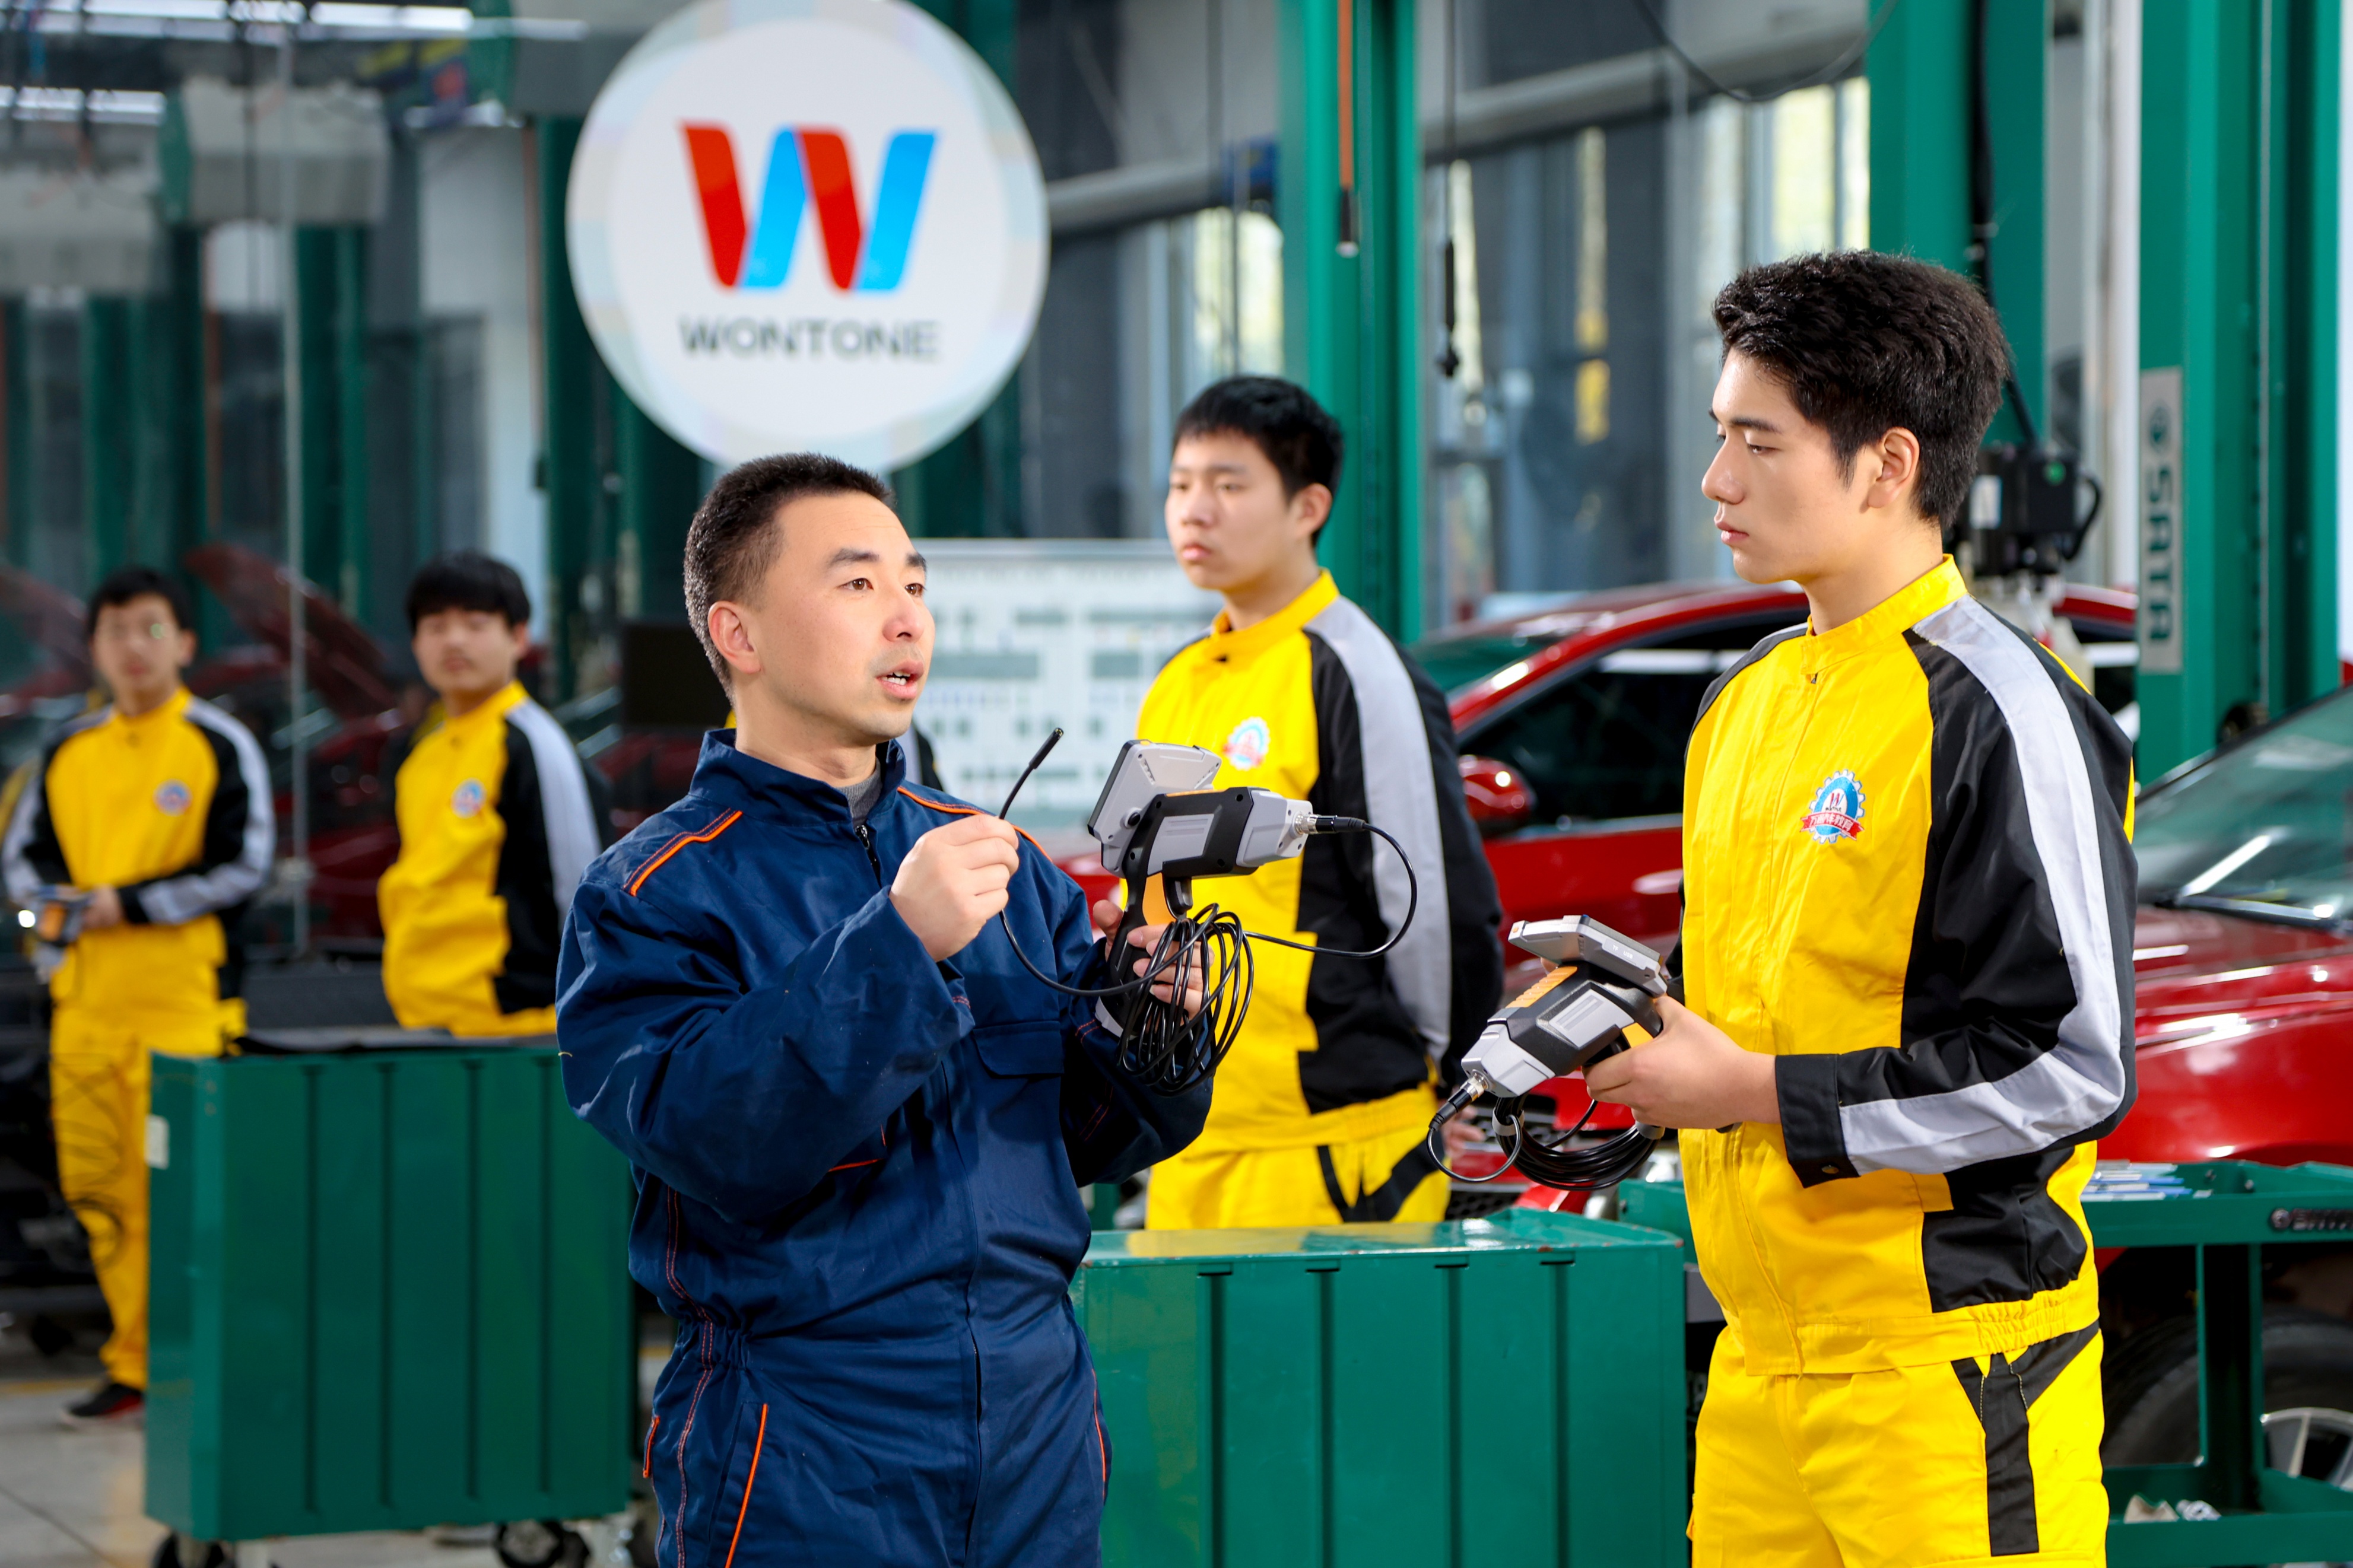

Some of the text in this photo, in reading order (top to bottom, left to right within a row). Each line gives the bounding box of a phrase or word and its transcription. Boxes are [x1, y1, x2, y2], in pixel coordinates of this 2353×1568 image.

[679, 315, 940, 361] WONTONE
[2147, 463, 2173, 643] SATA
[1623, 950, 1633, 959] USB
